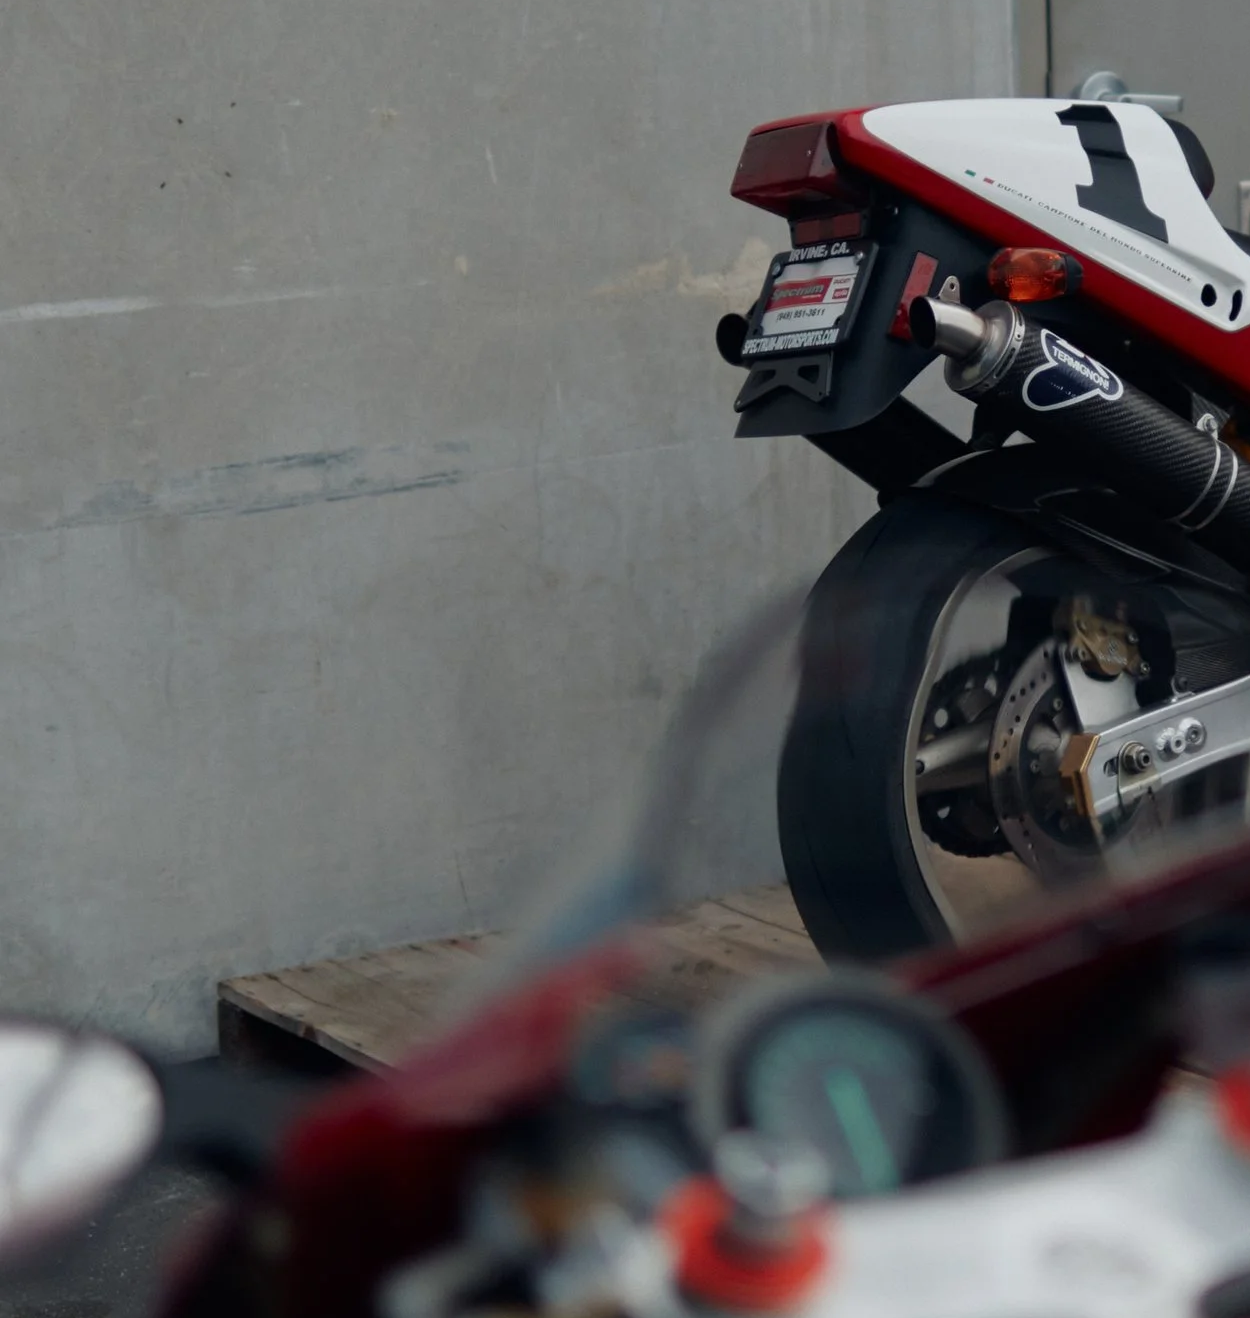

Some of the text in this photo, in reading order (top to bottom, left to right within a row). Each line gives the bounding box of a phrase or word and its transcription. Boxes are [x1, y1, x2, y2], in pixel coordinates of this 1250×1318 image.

[1055, 104, 1169, 244] 1
[997, 183, 1033, 202] DUCATI
[1038, 201, 1085, 227] CAMPIONE
[1089, 226, 1108, 238] DEL
[1110, 236, 1143, 256] MONDO
[788, 241, 850, 262] IRVINE, CA.
[1052, 345, 1110, 391] TERMIGNONI
